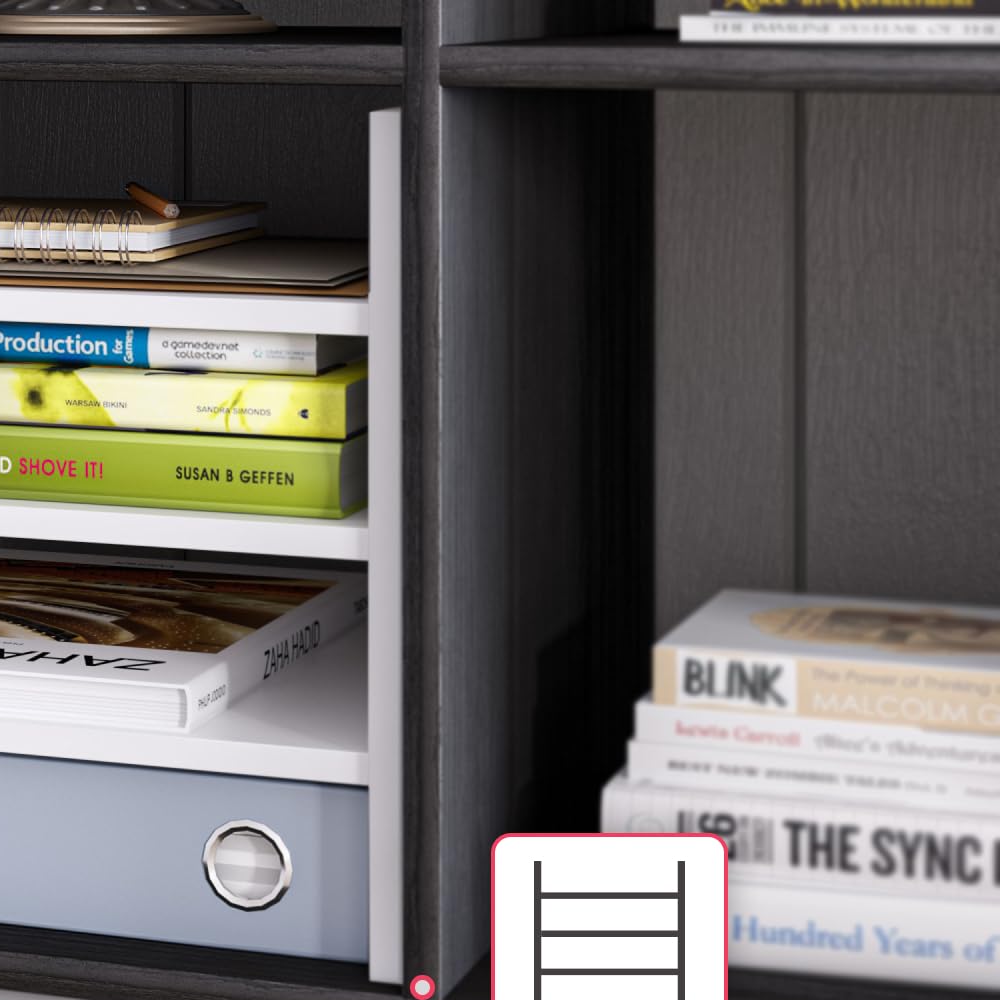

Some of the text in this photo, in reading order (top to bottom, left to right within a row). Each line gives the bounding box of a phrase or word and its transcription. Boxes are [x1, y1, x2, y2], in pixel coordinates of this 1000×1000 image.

[112, 338, 123, 355] for
[123, 329, 135, 364] Games
[175, 350, 227, 361] collection
[65, 398, 128, 409] WARSAW BIKINI
[196, 406, 272, 417] SANDRA SIMONDS
[19, 457, 77, 478] SHOVE
[85, 461, 104, 480] IT!
[175, 466, 295, 486] SUSAN B GEFFEN
[263, 620, 321, 681] ZAHA HADID
[682, 657, 788, 708] BLINK
[811, 690, 969, 722] MALCOLM
[783, 819, 862, 873] THE
[870, 828, 982, 889] SYNC
[731, 914, 864, 955] Hundred
[873, 925, 955, 957] Years
